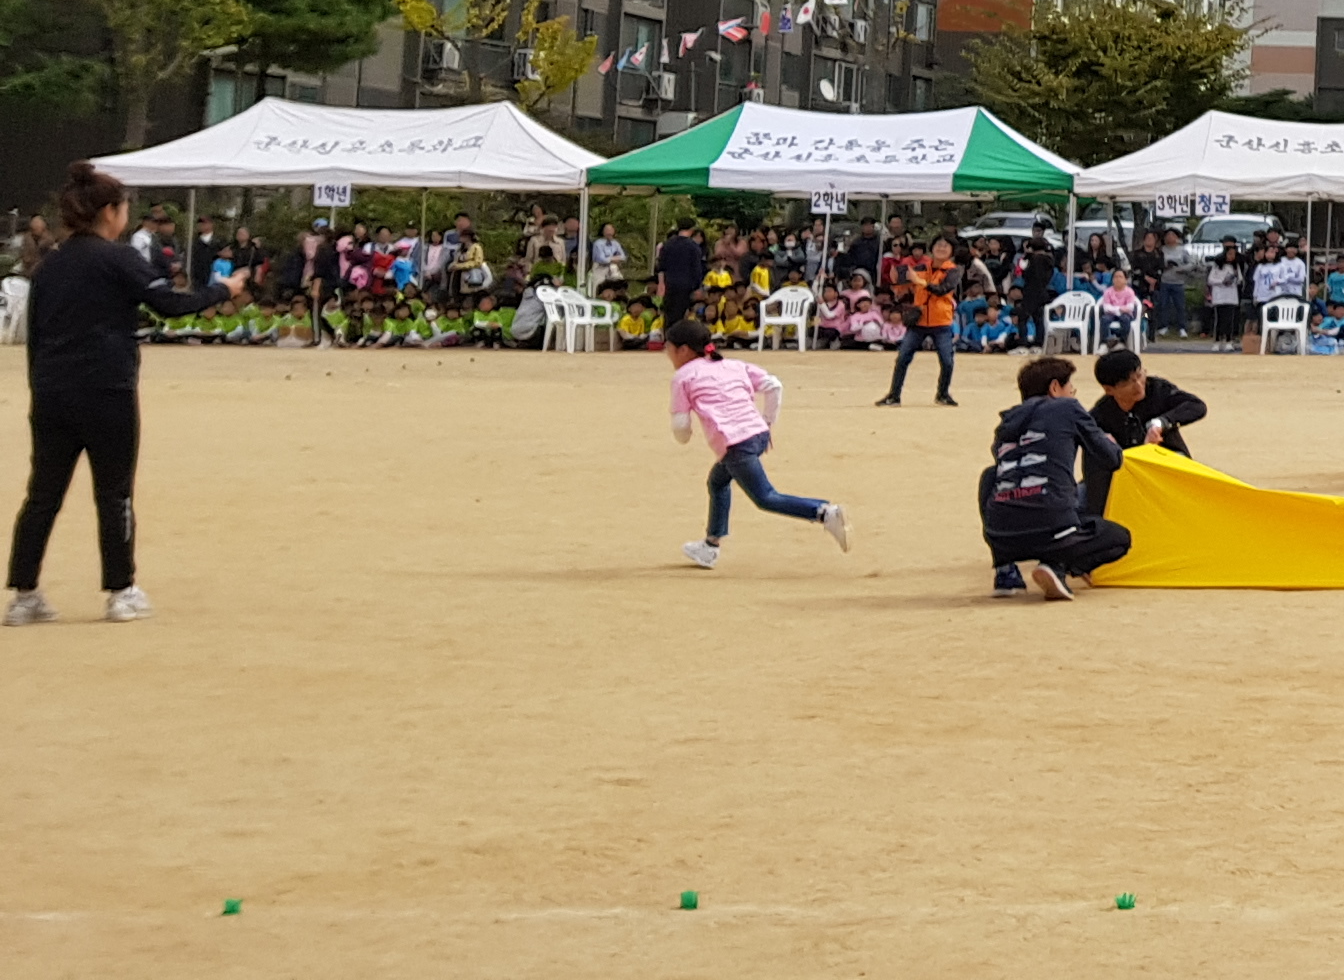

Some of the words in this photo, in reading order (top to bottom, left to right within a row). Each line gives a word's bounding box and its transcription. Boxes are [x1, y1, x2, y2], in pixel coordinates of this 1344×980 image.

[317, 184, 347, 203] 1학년
[813, 191, 846, 212] 2학년
[1157, 194, 1190, 214] 3학년
[1198, 193, 1229, 214] 청군
